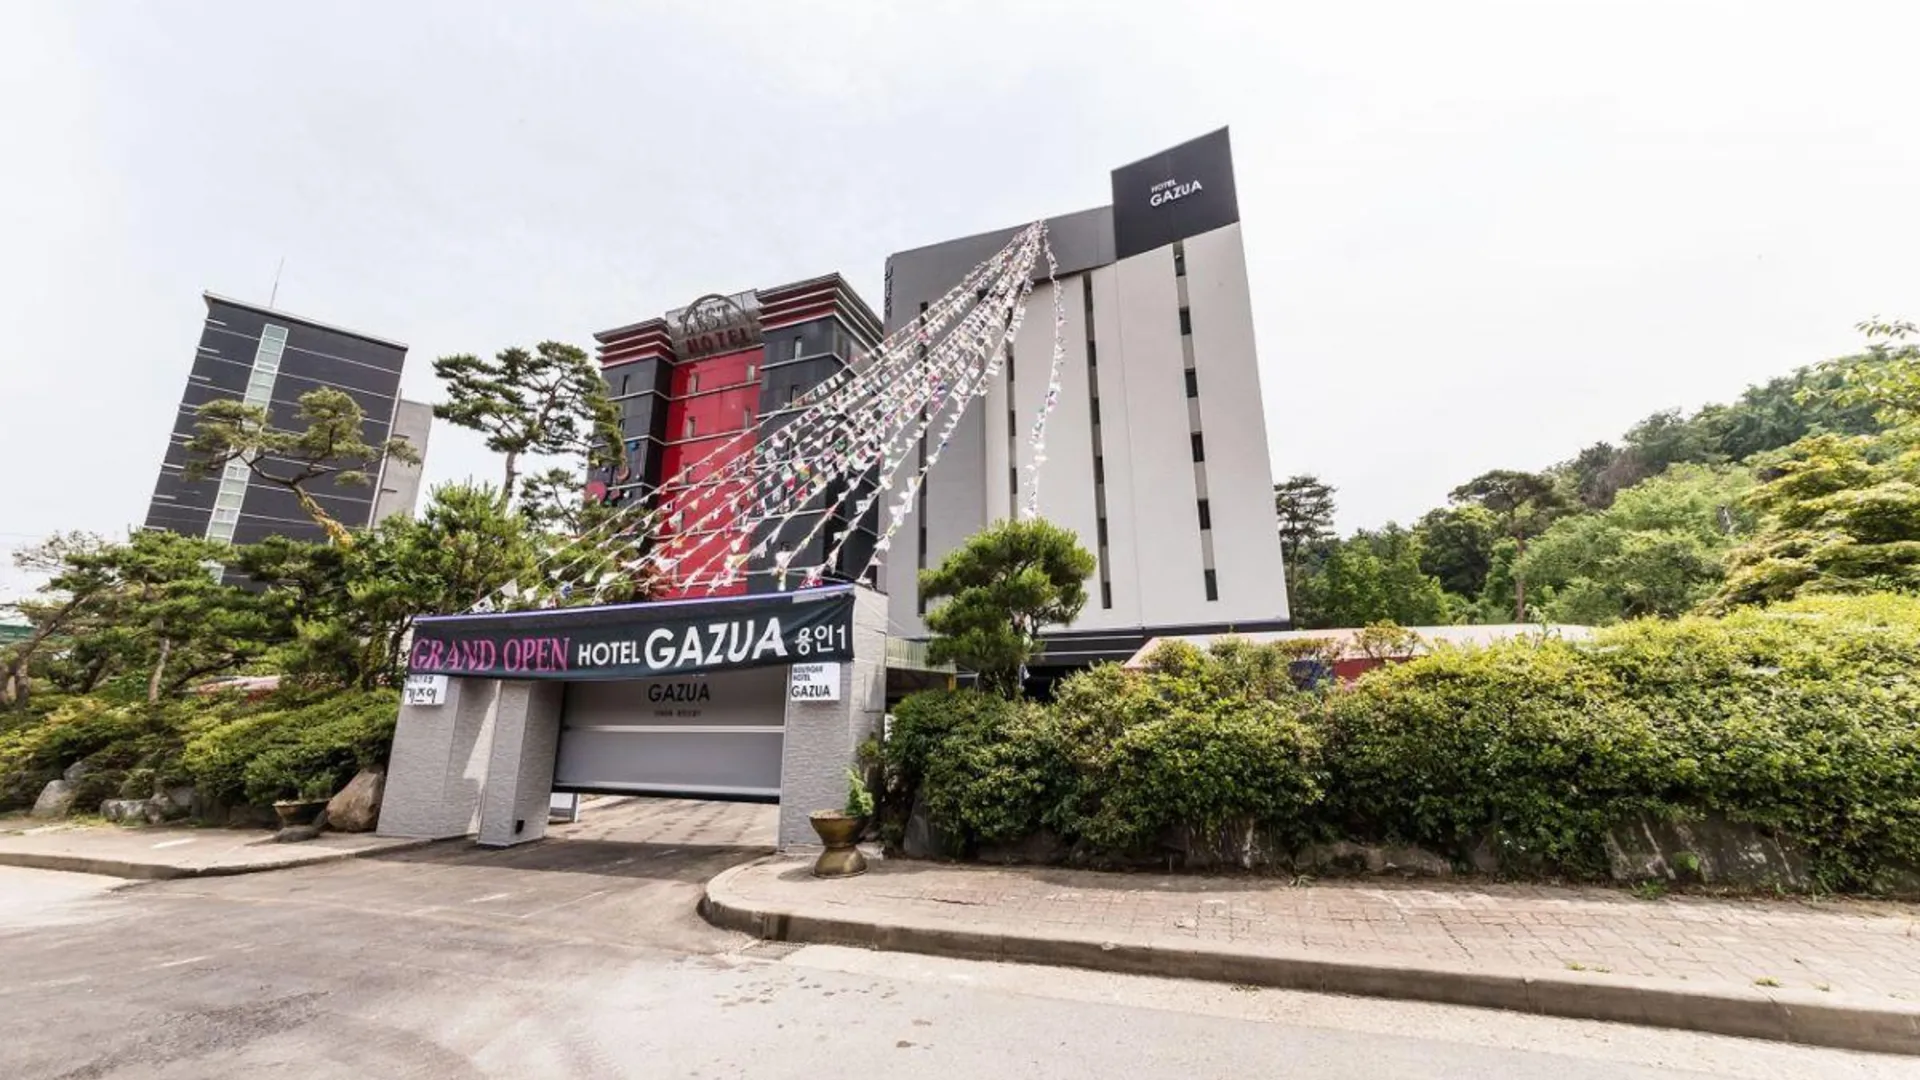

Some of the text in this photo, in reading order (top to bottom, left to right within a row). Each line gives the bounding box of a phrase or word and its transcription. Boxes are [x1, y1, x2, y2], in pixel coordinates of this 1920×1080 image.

[1150, 180, 1203, 207] GAZUA
[1151, 179, 1177, 193] HOTEL
[411, 637, 496, 671] GRAND
[503, 636, 570, 671] OPEN
[578, 640, 640, 666] HOTEL
[645, 617, 788, 670] GAZUA
[648, 682, 710, 702] GAZUA
[791, 685, 831, 698] GAZUA
